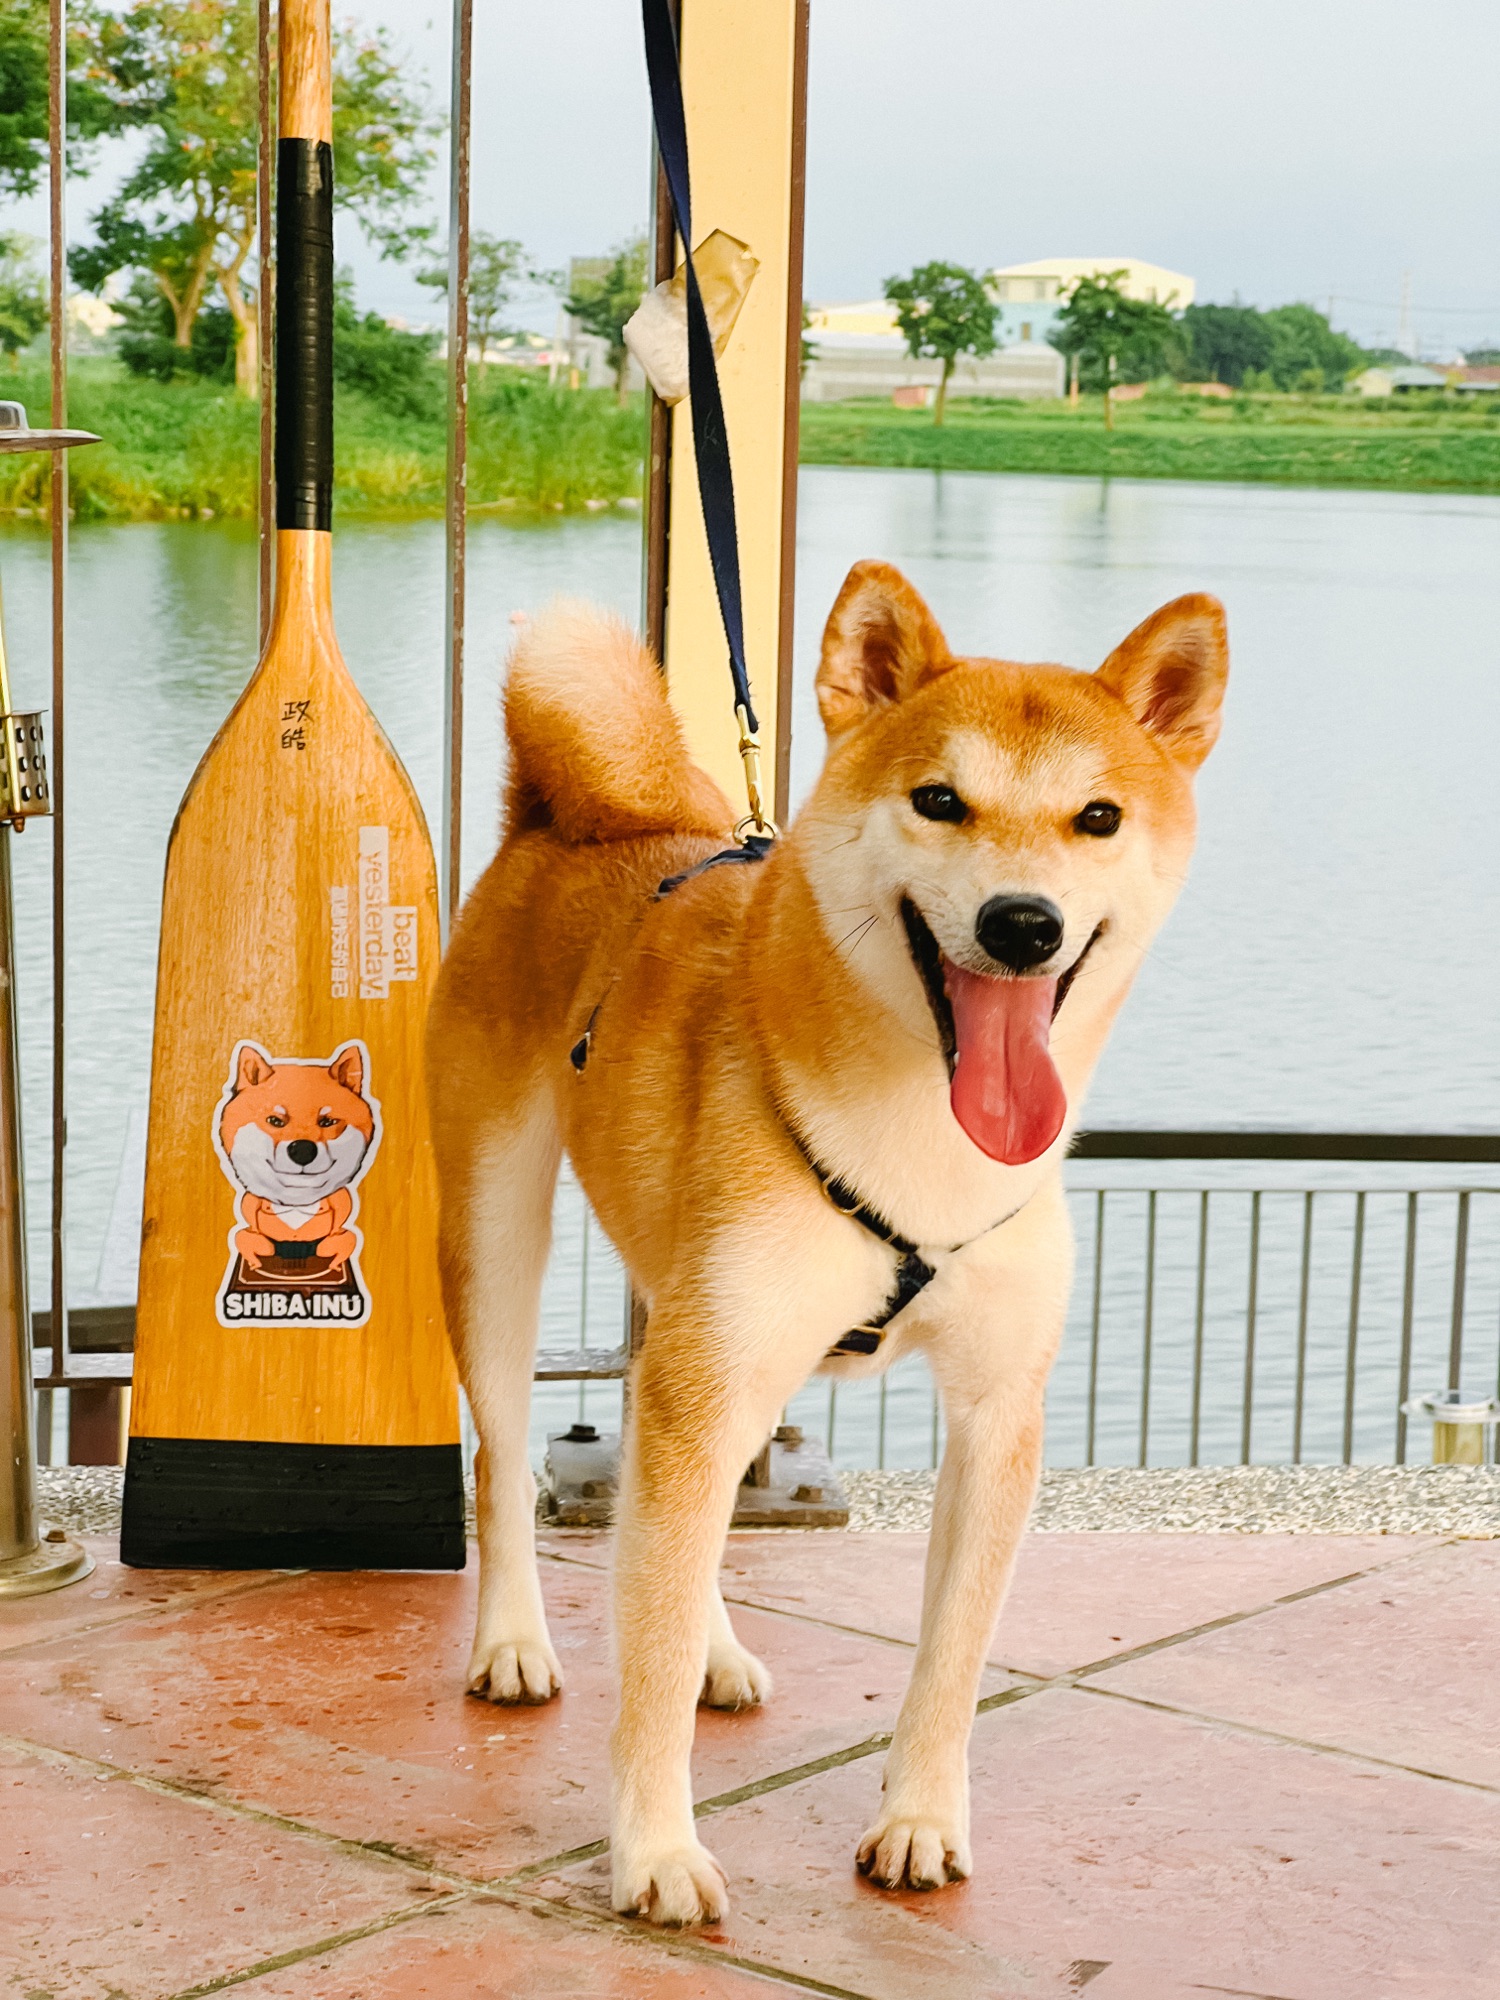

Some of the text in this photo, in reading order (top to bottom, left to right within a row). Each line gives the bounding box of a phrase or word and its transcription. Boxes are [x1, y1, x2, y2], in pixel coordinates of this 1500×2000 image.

[356, 851, 389, 996] yesterday.
[392, 912, 417, 977] beat
[225, 1292, 362, 1319] SHIBA INU
